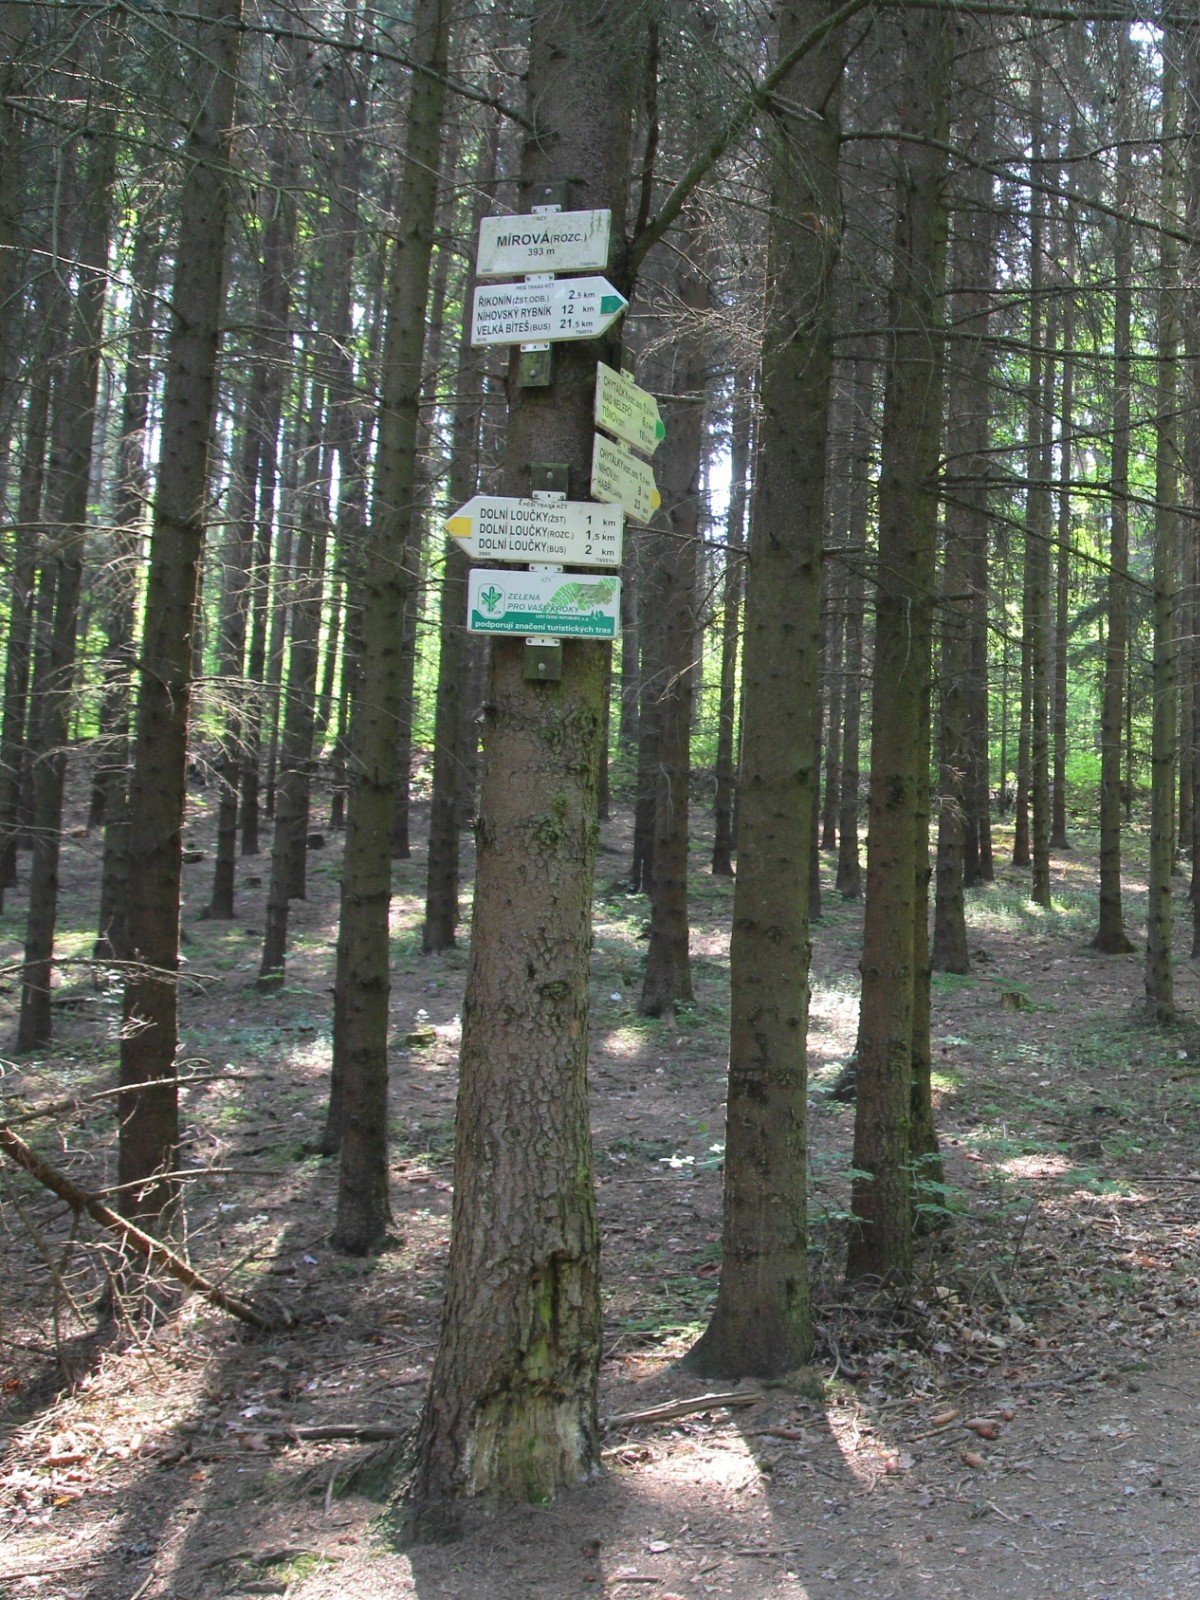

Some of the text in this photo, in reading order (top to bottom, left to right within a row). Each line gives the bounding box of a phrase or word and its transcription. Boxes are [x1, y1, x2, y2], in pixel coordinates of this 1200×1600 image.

[527, 247, 555, 257] 393 m
[583, 291, 595, 299] km
[477, 304, 595, 321] NÍHOVSKÝ RYBNÍK 12 km
[476, 321, 504, 336] VELKÁ
[581, 320, 594, 328] km
[480, 507, 509, 520] DOLNÍ
[586, 514, 592, 525] 1
[602, 519, 616, 527] km
[479, 522, 508, 535] DOLNÍ
[585, 529, 600, 541] 1,5
[602, 533, 615, 541] km
[478, 537, 507, 550] DOLNÍ
[584, 544, 593, 555] 2
[601, 548, 615, 556] km
[507, 602, 526, 611] PRO
[552, 604, 579, 613] KROKY
[475, 620, 612, 634] podporují značení turistických tras
